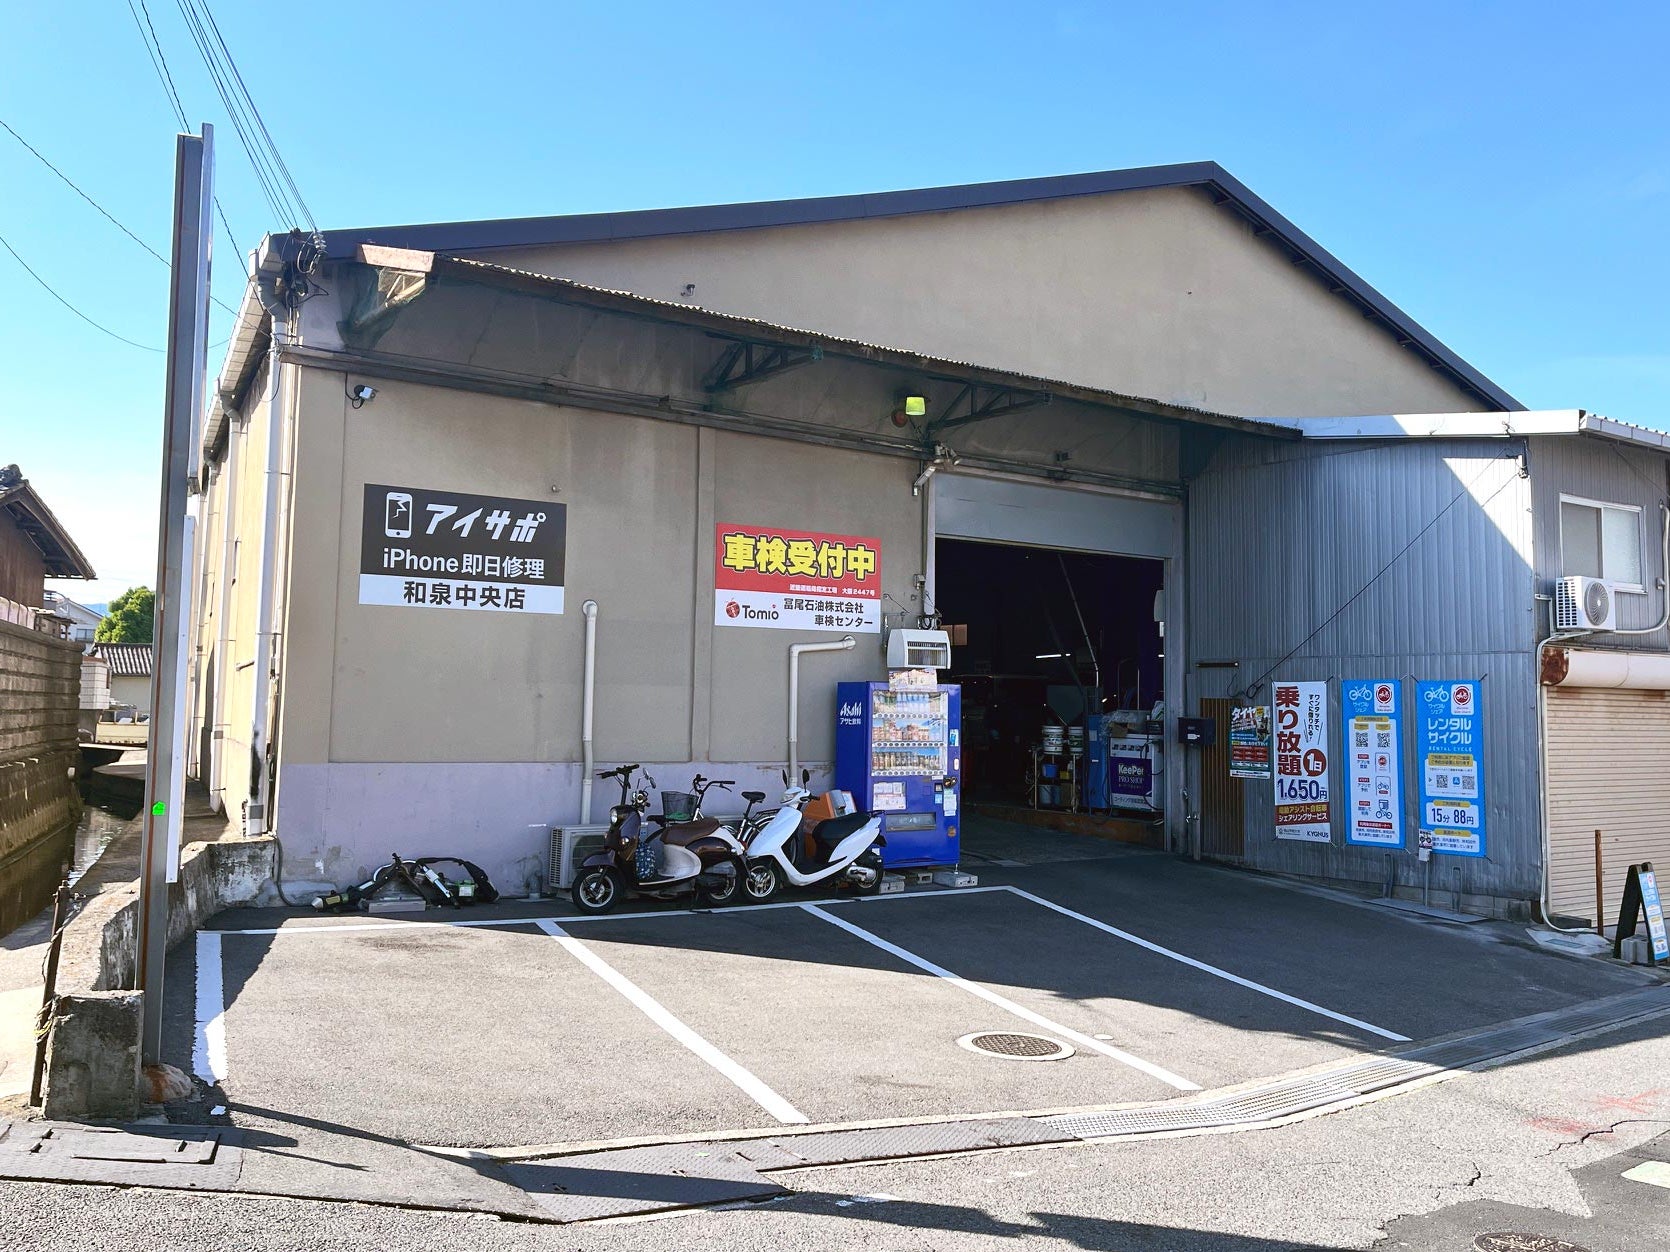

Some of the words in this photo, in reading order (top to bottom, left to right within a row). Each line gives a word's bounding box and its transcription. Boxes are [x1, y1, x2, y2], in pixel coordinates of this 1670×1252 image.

[425, 503, 547, 543] アイサポ
[722, 532, 876, 581] 車検受付中
[403, 580, 526, 610] 和泉中央店
[742, 604, 779, 620] Tomio
[814, 615, 873, 627] 車検センター
[840, 701, 862, 716] Asahi
[1231, 706, 1256, 721] タイヤ
[1276, 686, 1302, 776] 乗り放題
[1427, 718, 1472, 731] レンタル
[1427, 731, 1472, 745] サイクル
[1307, 753, 1322, 772] 1日
[1279, 804, 1328, 814] 電動アシスト自転車
[1432, 808, 1450, 823] 15分
[1453, 809, 1474, 825] 88円
[1279, 812, 1328, 822] シェアリングサービス
[1307, 830, 1329, 839] KYGNUS
